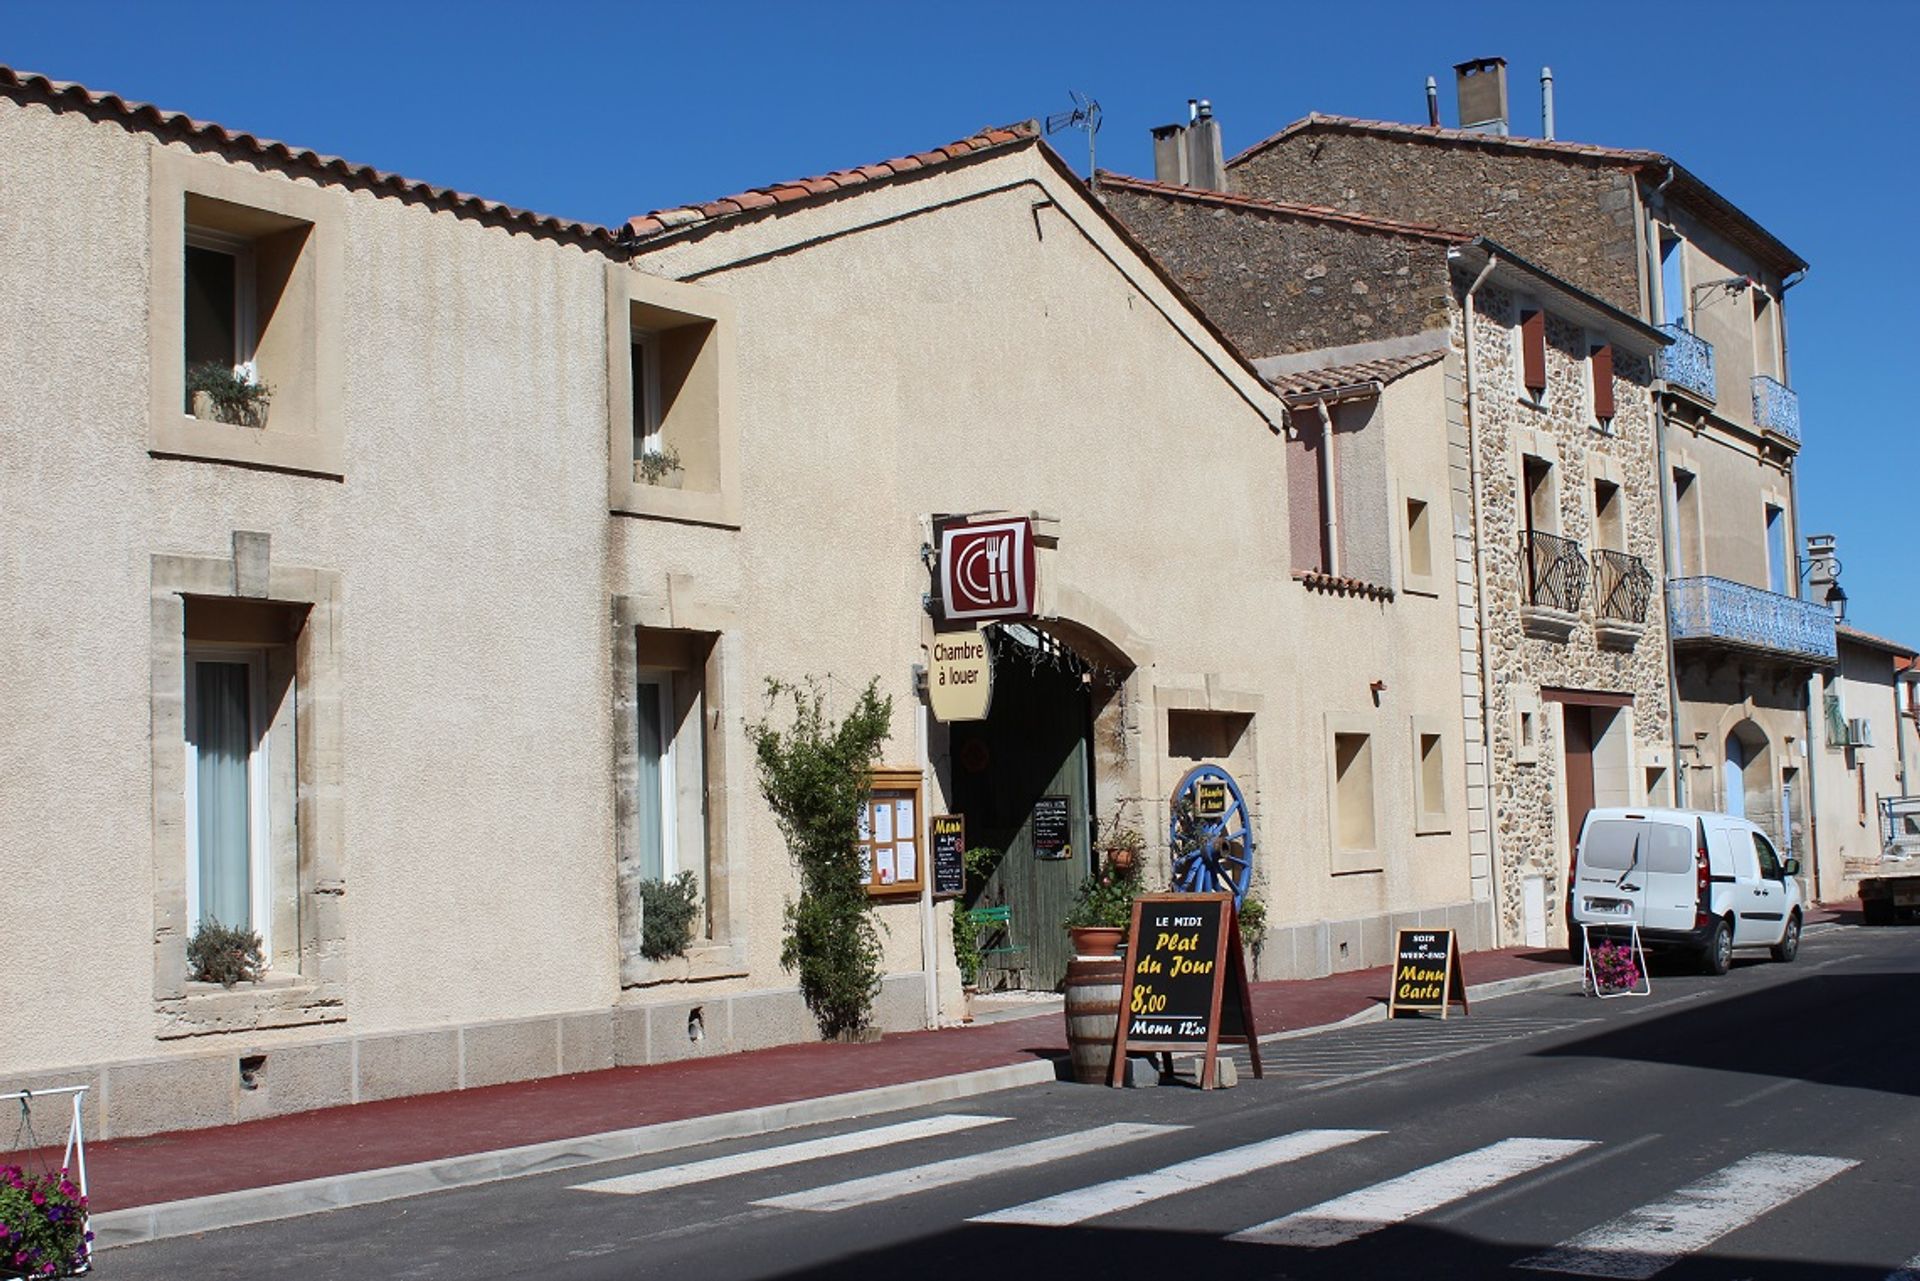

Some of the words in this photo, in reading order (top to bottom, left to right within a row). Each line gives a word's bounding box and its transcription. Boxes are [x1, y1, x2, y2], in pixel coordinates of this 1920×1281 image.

[934, 641, 983, 661] Chambre
[939, 666, 945, 686] à
[949, 666, 978, 685] louer
[934, 819, 961, 835] Menu
[1156, 917, 1169, 927] LE
[1174, 917, 1203, 927] MIDI
[1155, 932, 1199, 951] Plat
[1137, 954, 1162, 974] du
[1170, 955, 1214, 978] Jour
[1399, 966, 1445, 981] Menu
[1399, 983, 1440, 999] Carte
[1130, 1020, 1173, 1035] Menu
